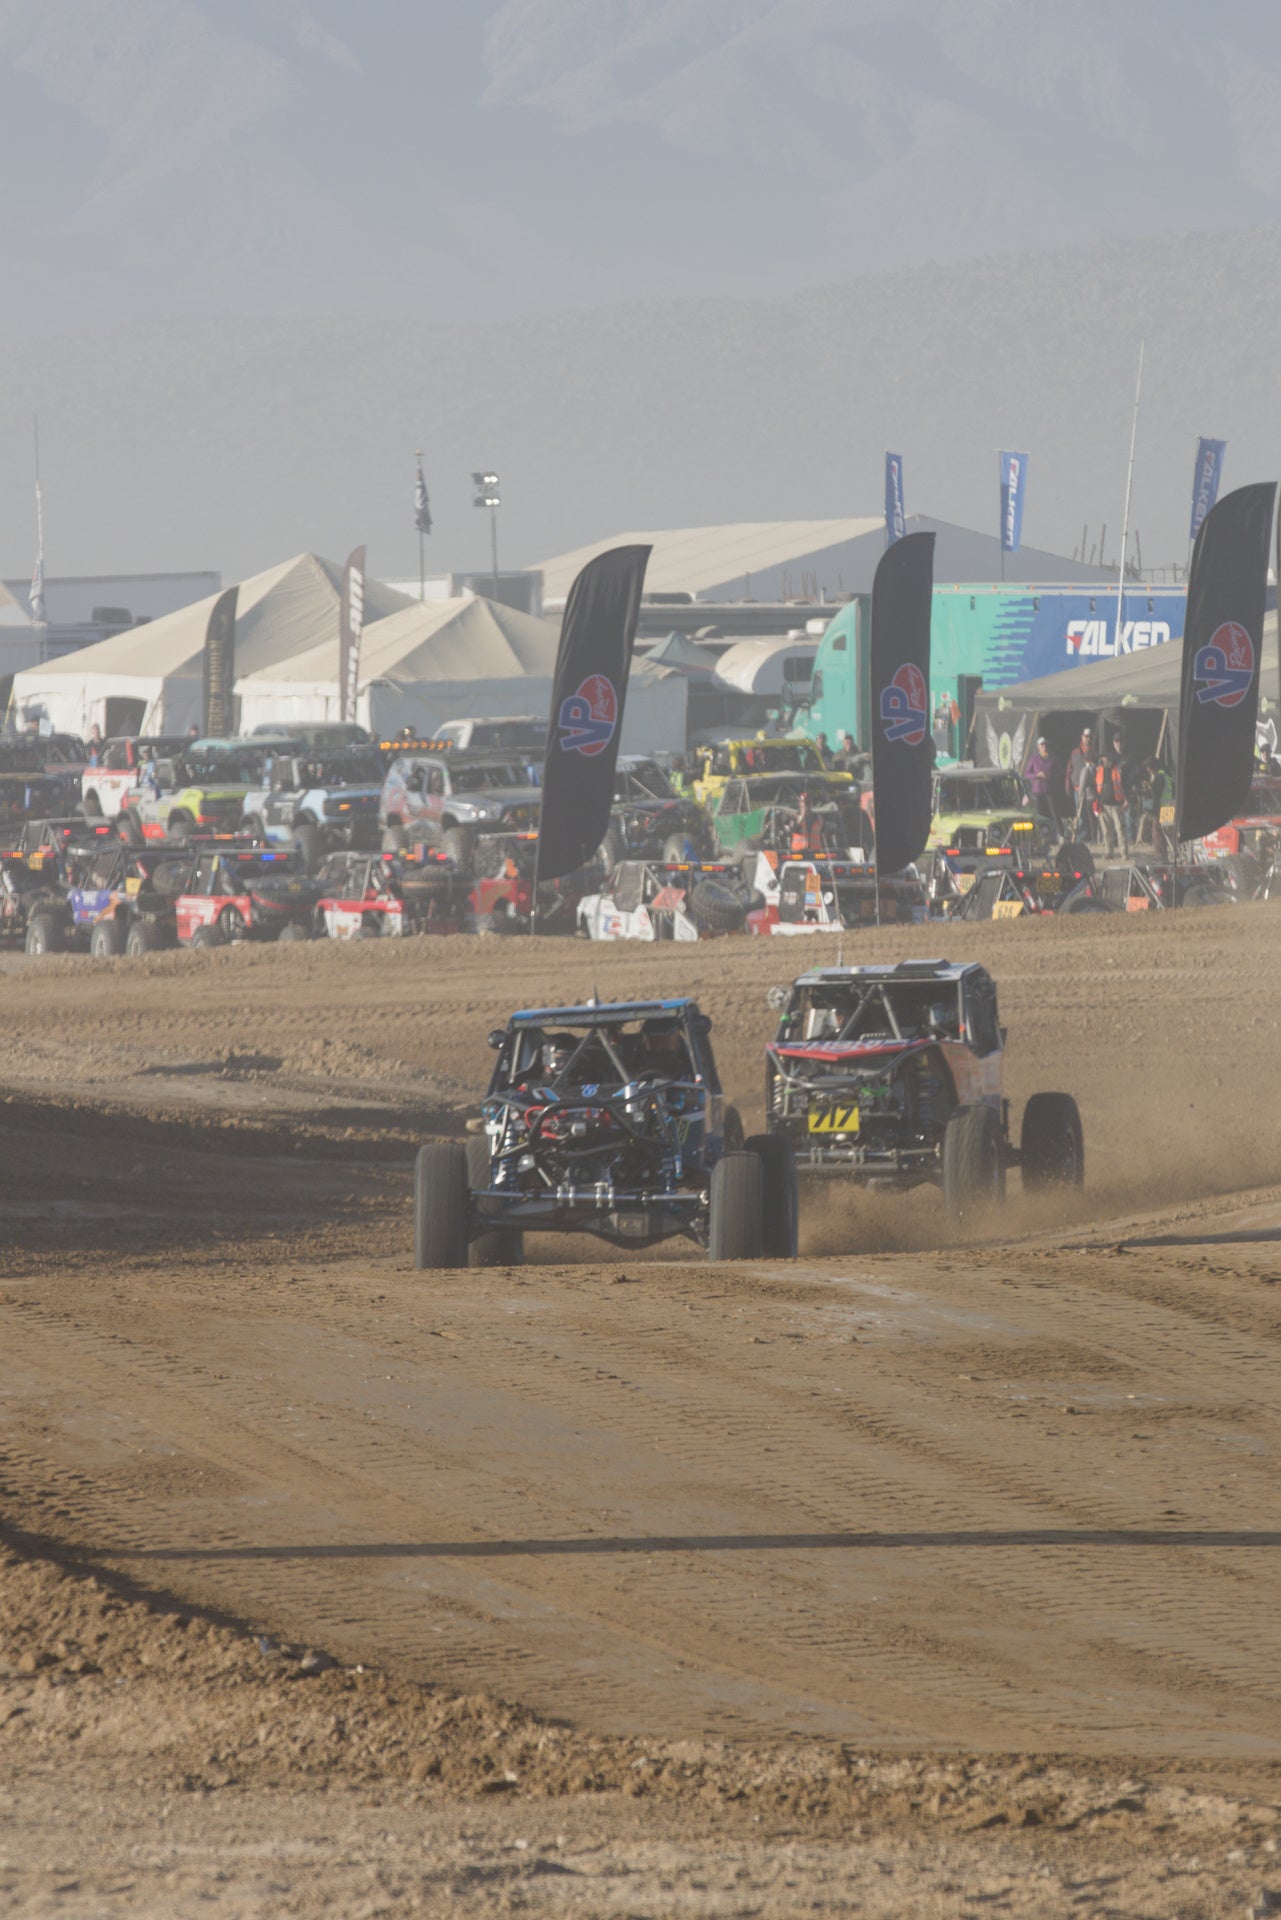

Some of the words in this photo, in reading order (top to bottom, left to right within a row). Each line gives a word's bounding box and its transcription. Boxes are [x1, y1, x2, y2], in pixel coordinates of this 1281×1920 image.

[1064, 620, 1170, 656] FALKEN
[1194, 645, 1254, 704] VP
[559, 695, 617, 752] VP
[881, 685, 927, 741] VP
[813, 1103, 855, 1128] 717
